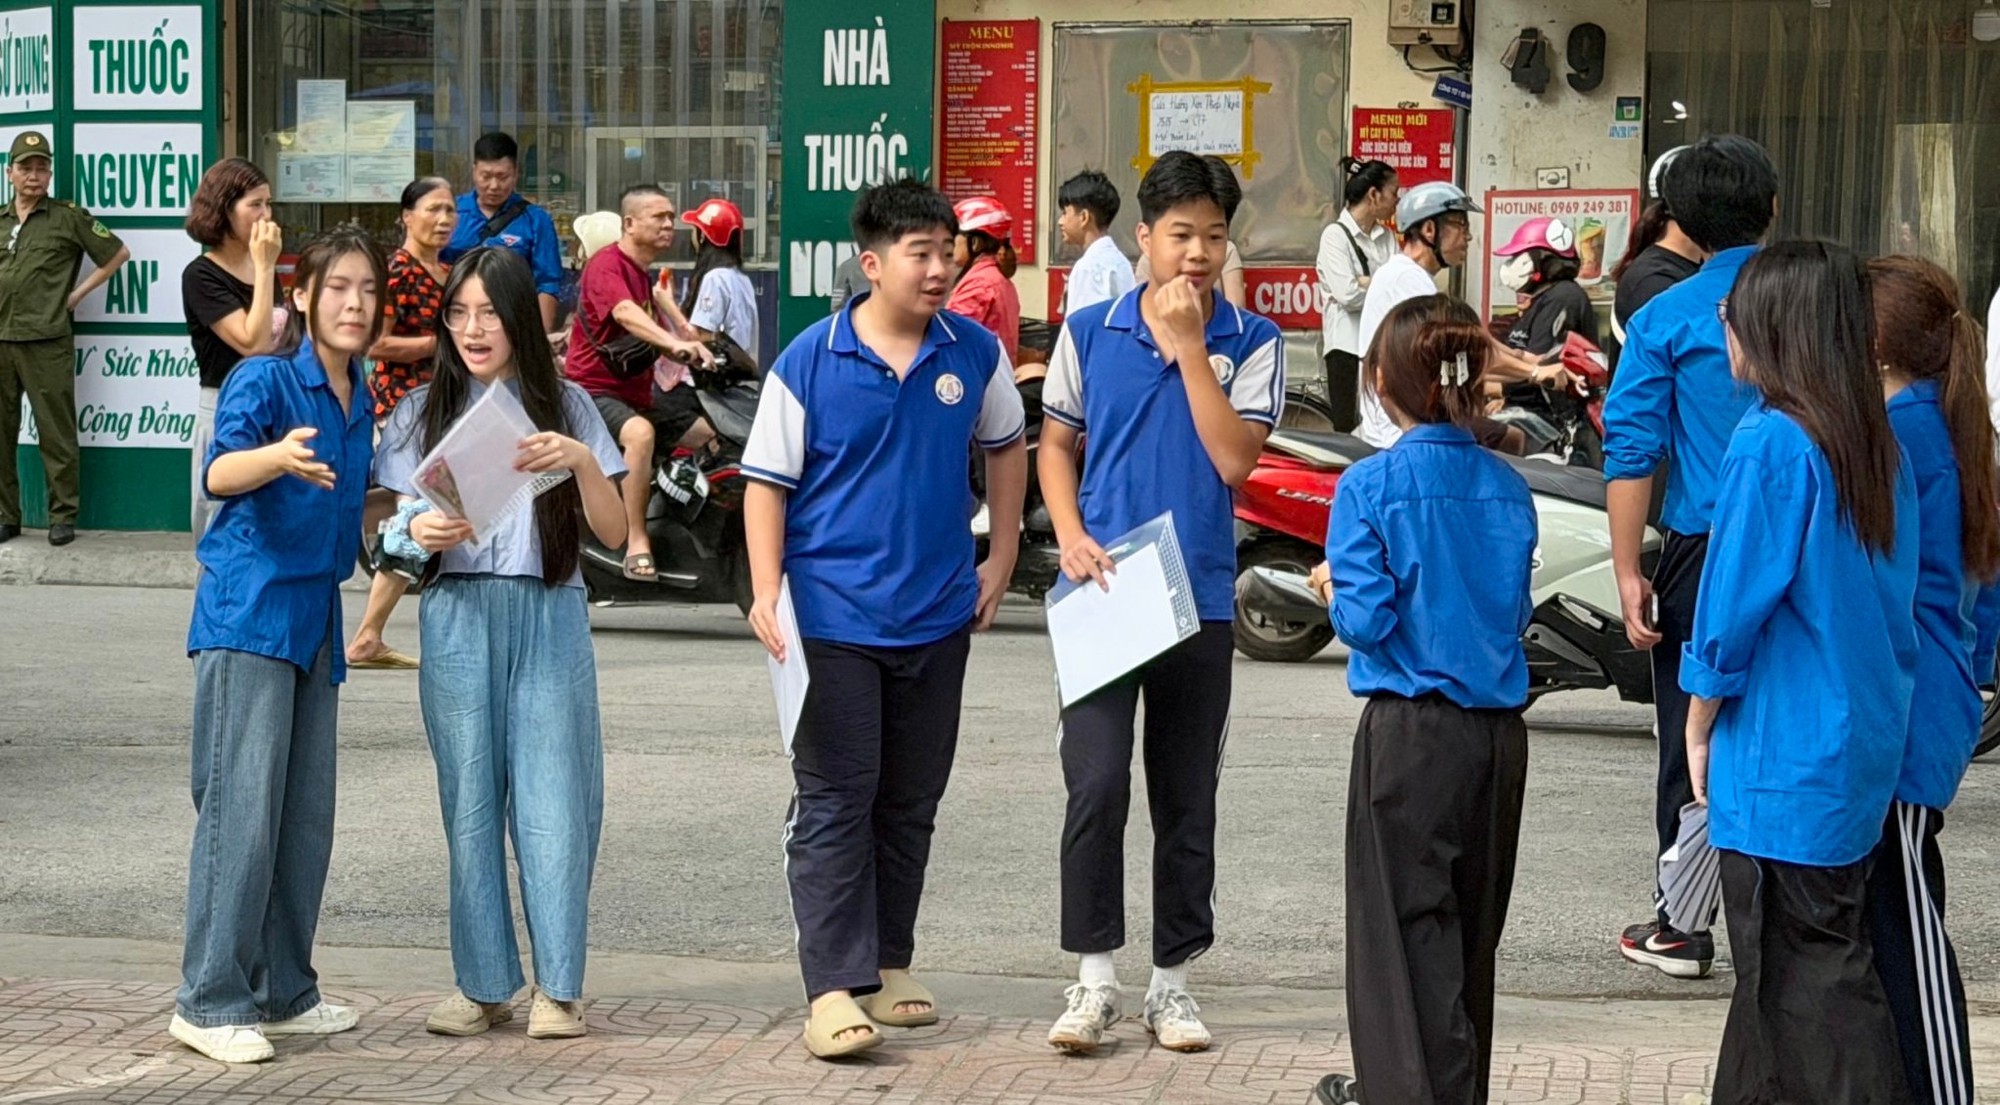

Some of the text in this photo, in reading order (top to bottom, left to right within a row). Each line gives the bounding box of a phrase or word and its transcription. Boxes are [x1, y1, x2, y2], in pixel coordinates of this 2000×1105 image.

[88, 18, 189, 95] THUỐC
[823, 16, 890, 86] NHÀ
[969, 26, 1014, 39] MENU
[0, 17, 49, 109] Ử DỤNG
[1370, 114, 1427, 126] MENU MỚI
[75, 142, 199, 208] NGUYÊN
[804, 113, 908, 191] THUỐC
[1495, 200, 1628, 214] HOTLINE: 0969 249 381
[102, 346, 142, 377] Sức
[146, 347, 200, 378] Khỏe
[78, 404, 133, 441] Cộng
[138, 401, 196, 442] Đồng
